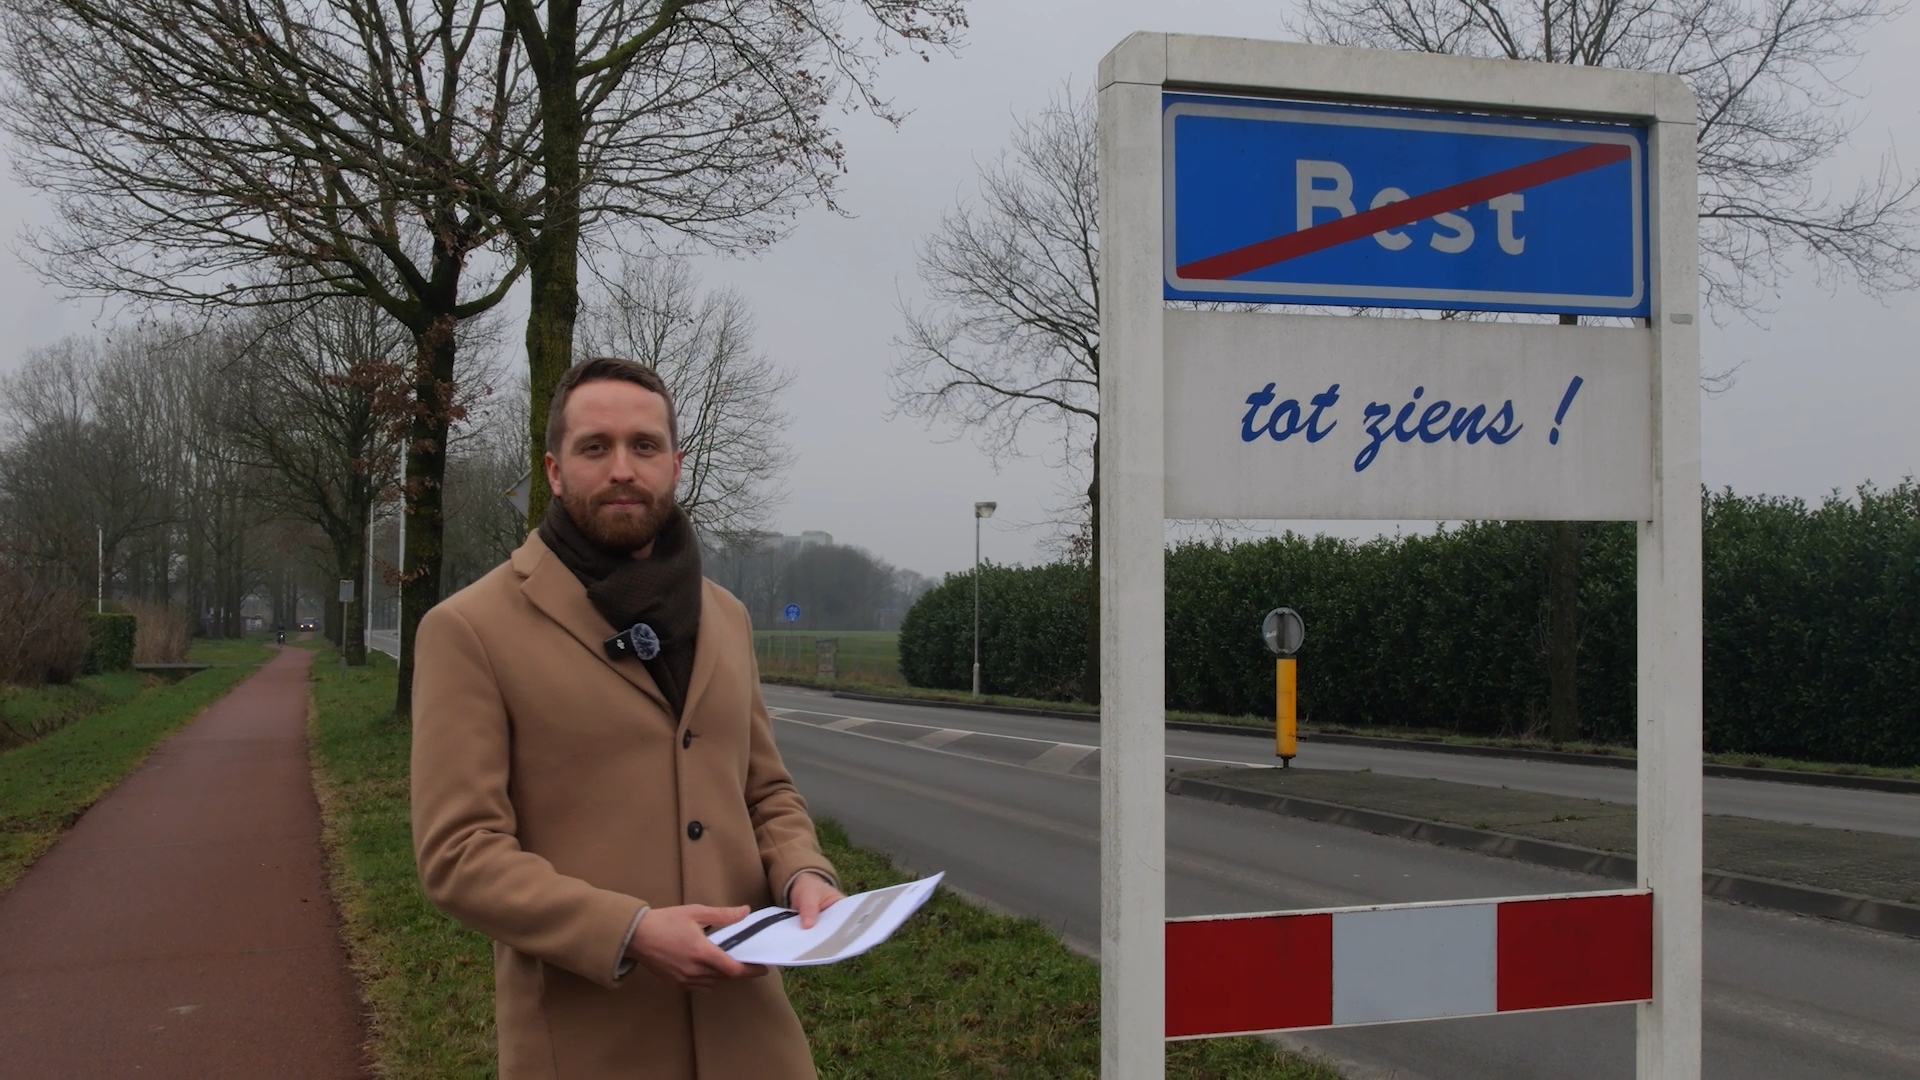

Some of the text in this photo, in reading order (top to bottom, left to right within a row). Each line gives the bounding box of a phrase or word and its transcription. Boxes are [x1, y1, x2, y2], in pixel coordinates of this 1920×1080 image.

[1241, 376, 1583, 472] tot ziens !
